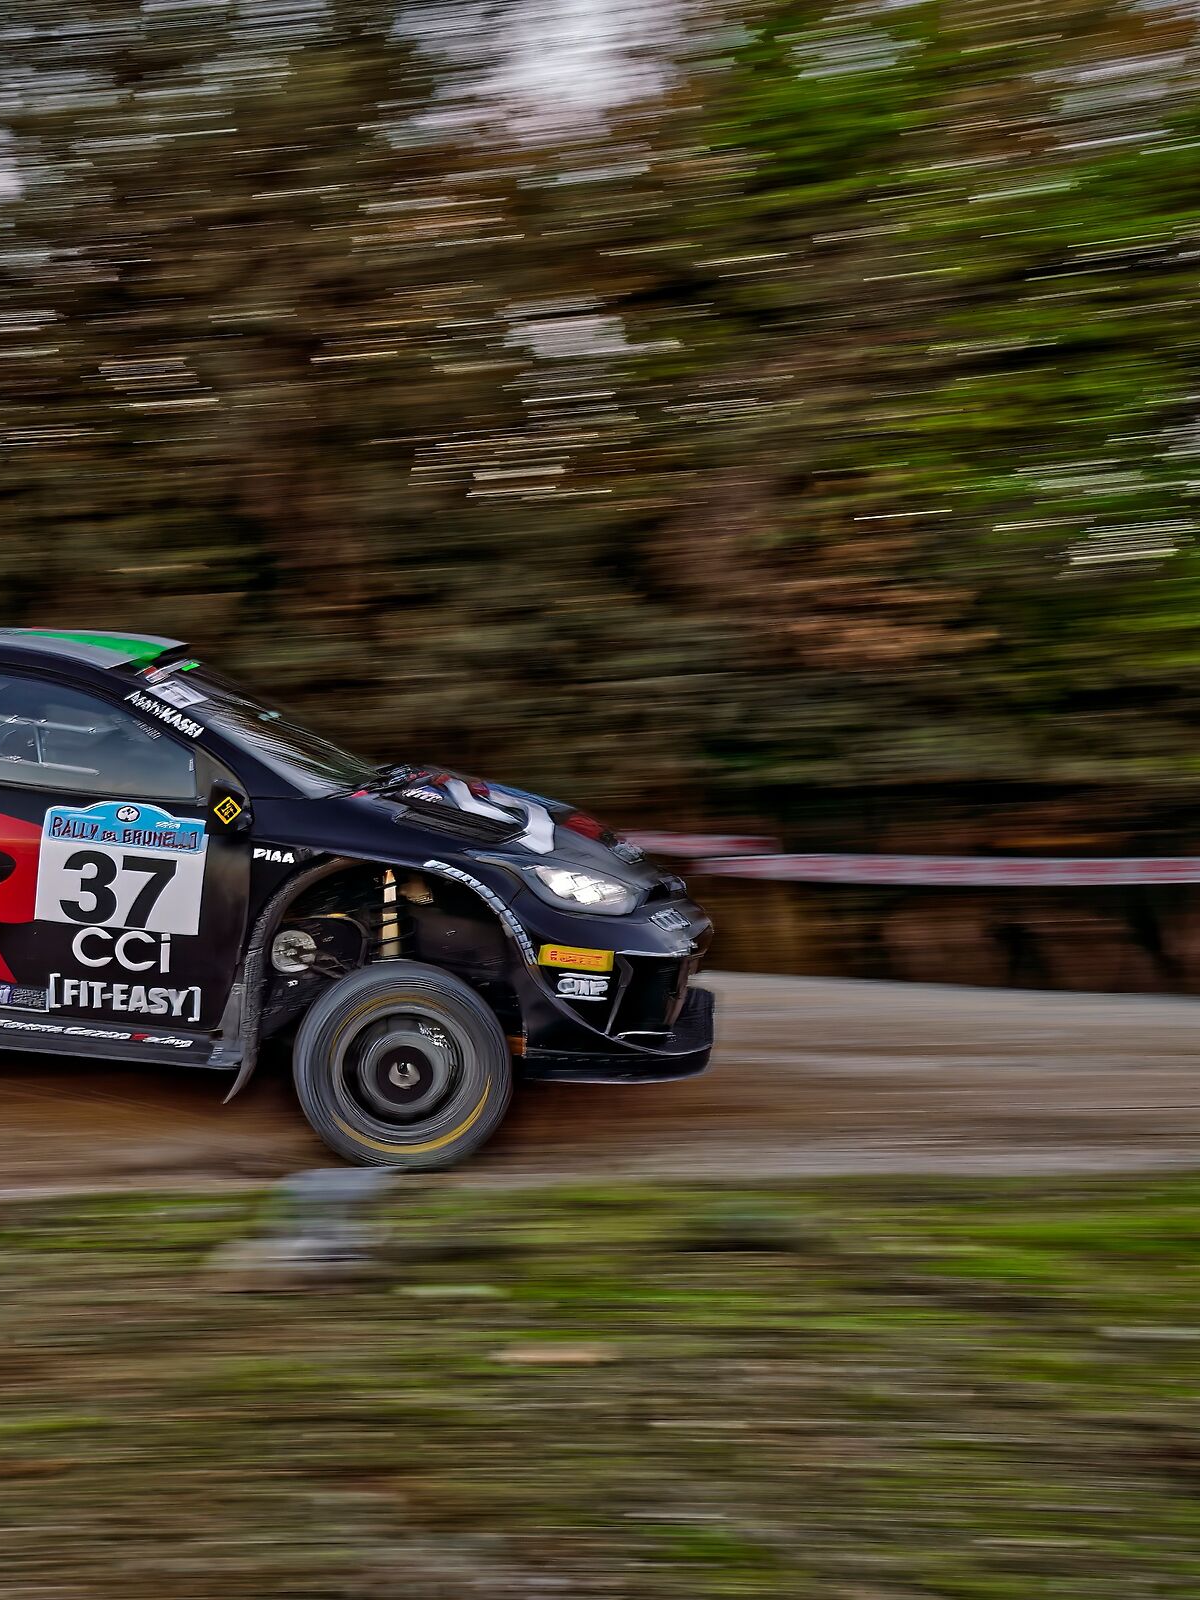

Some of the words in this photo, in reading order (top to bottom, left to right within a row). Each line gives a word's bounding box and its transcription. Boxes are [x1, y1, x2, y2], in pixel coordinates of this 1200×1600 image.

[51, 816, 99, 840] RALLY
[253, 848, 295, 864] PIAA
[59, 850, 178, 929] 37
